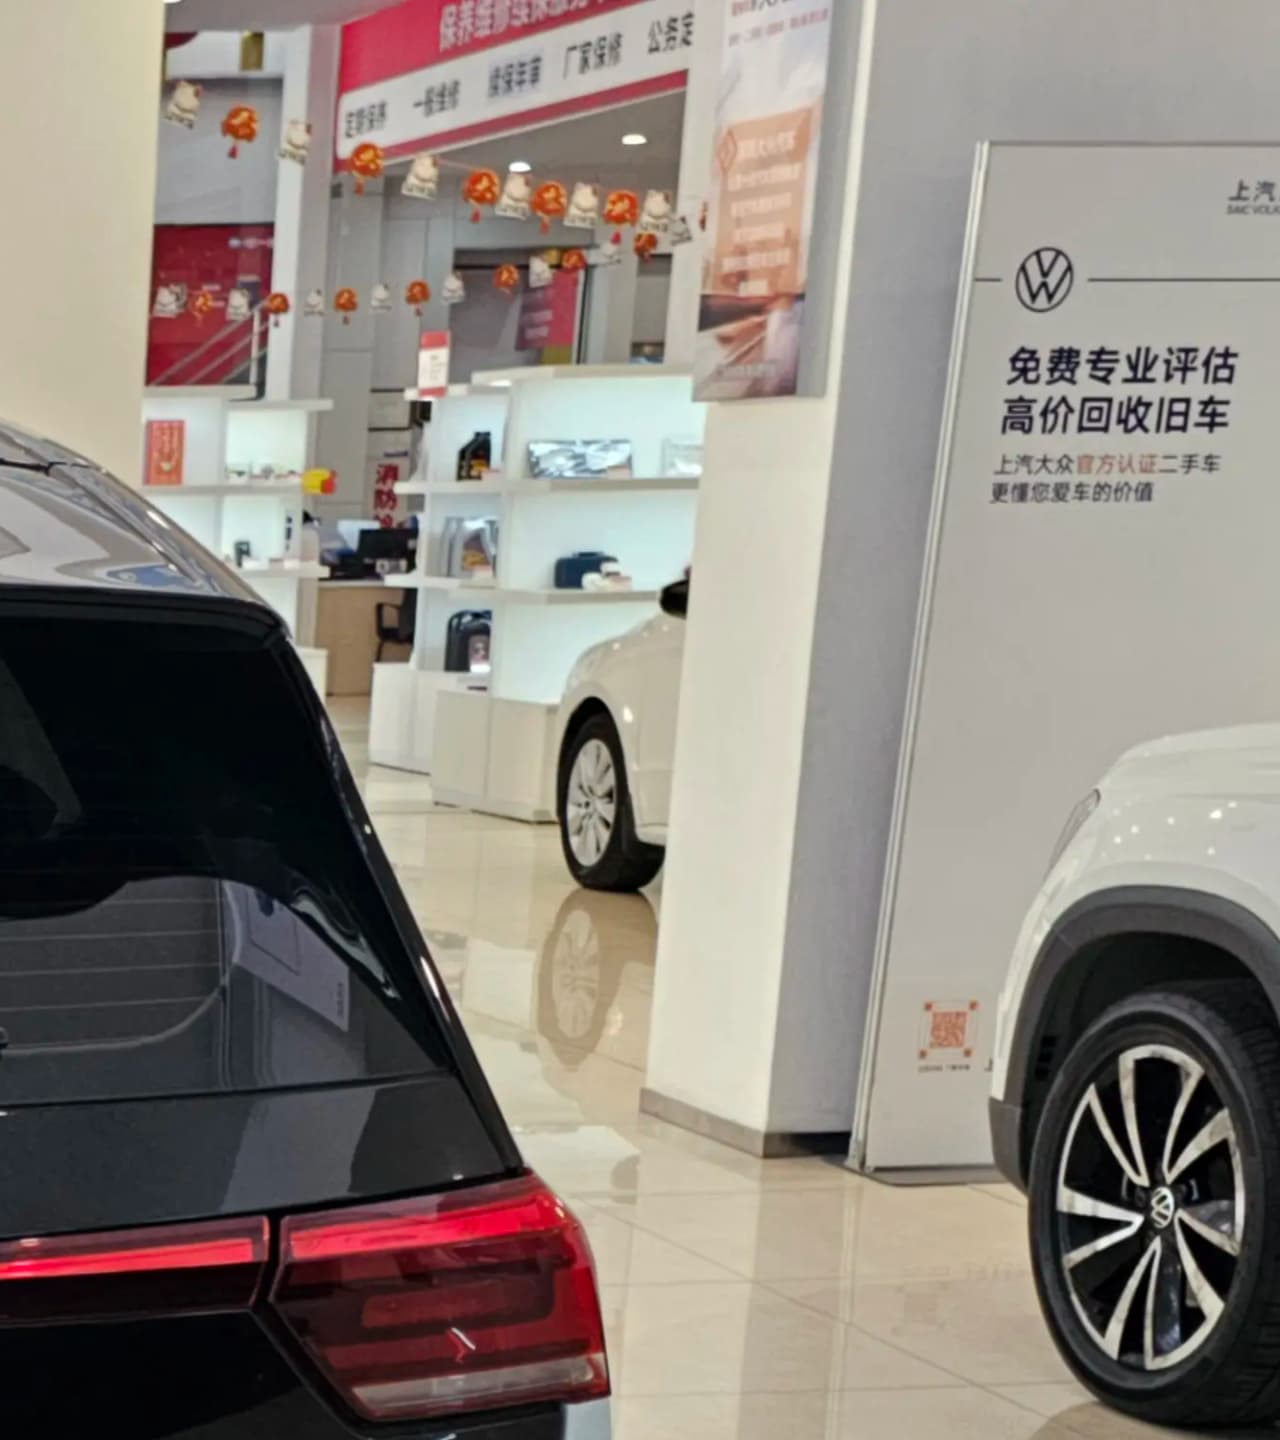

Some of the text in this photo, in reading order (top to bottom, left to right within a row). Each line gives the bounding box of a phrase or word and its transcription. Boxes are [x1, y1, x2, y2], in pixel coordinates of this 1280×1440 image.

[1006, 346, 1239, 386] 免费专业评估
[1001, 395, 1231, 435] 高价回收旧车
[993, 454, 1222, 475] 上汽大众官方认证二手车
[990, 481, 1155, 504] 更懂您爱车的价值
